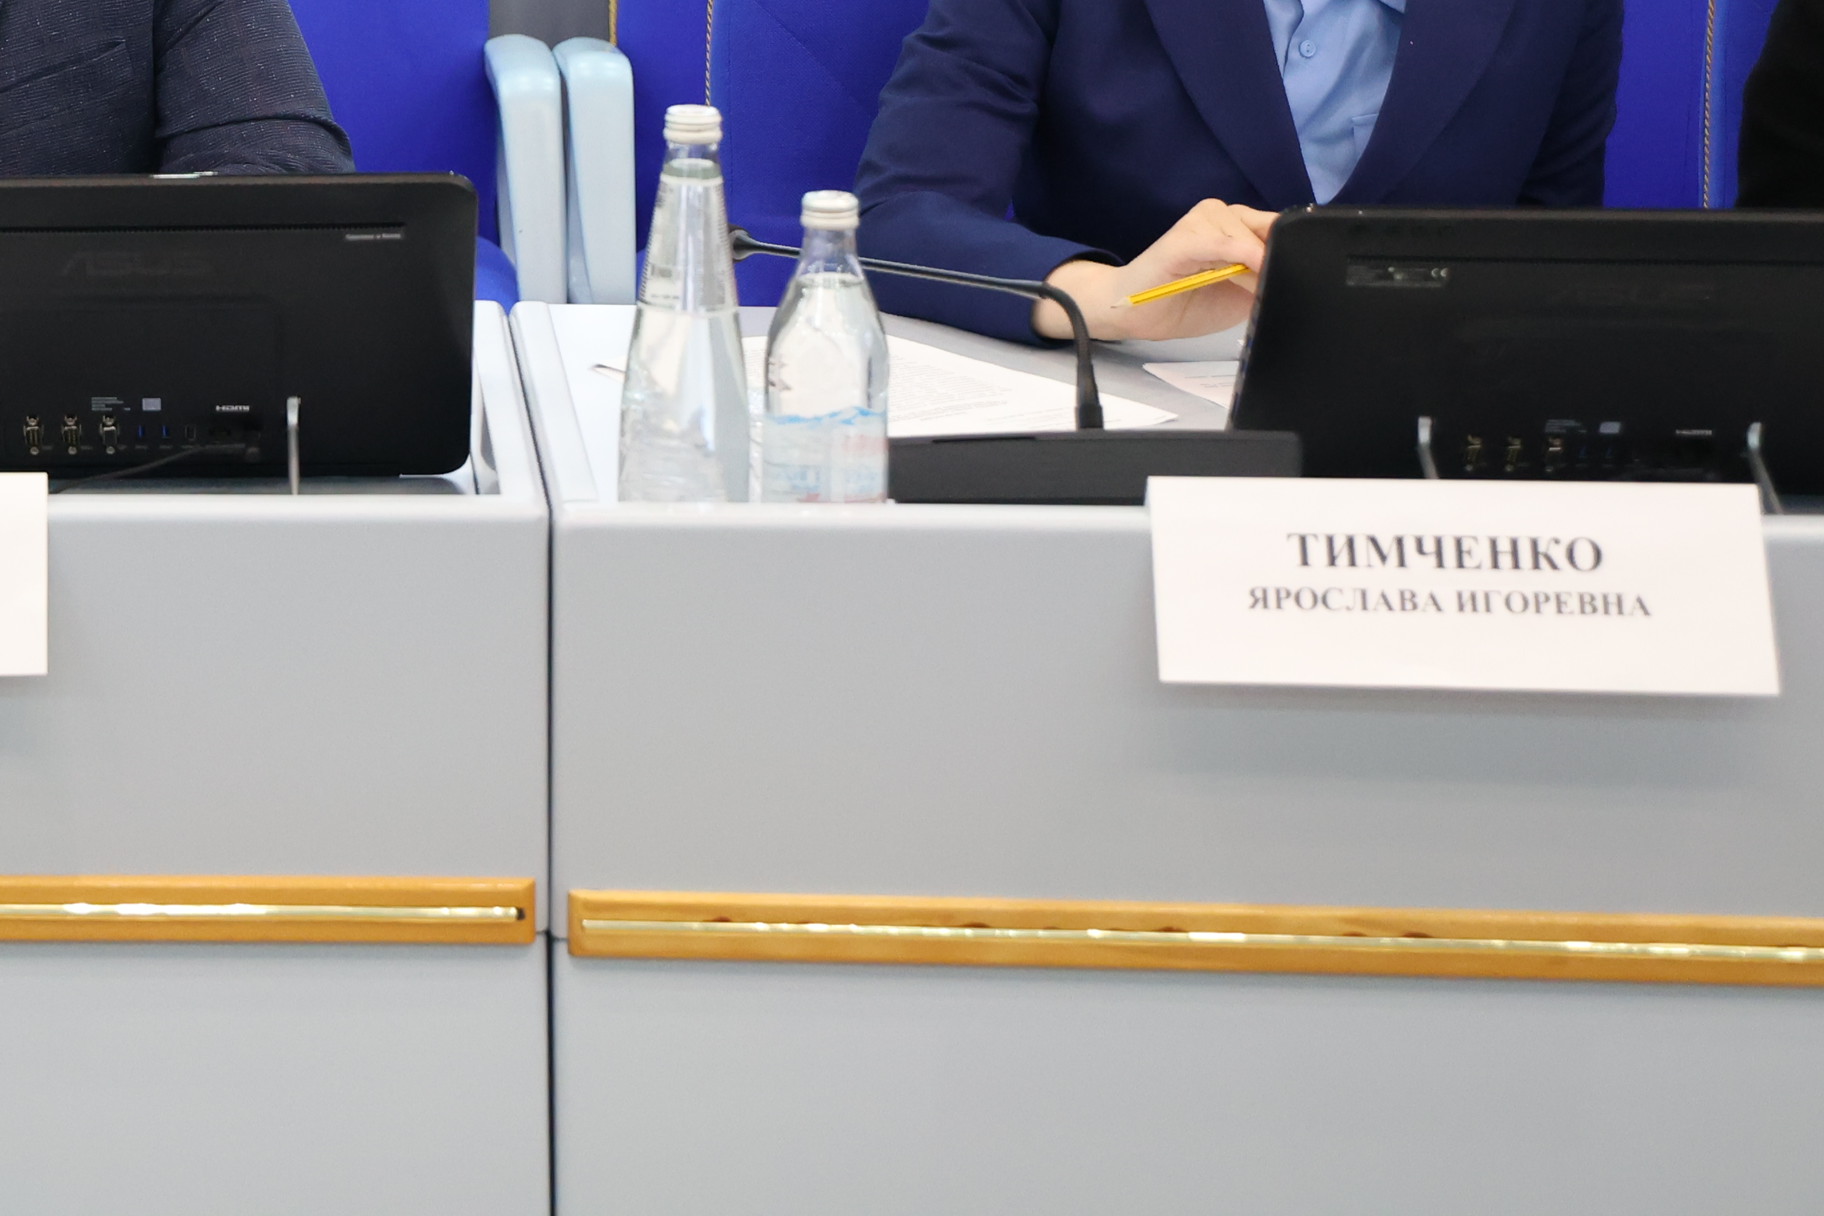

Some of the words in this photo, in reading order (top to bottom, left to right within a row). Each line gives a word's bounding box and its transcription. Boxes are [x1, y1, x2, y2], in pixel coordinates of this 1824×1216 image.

[1286, 532, 1603, 573] ТИМЧЕНКО
[1248, 586, 1444, 614] ЯРОСЛАВА
[1456, 590, 1652, 618] ИГОРЕВНА
